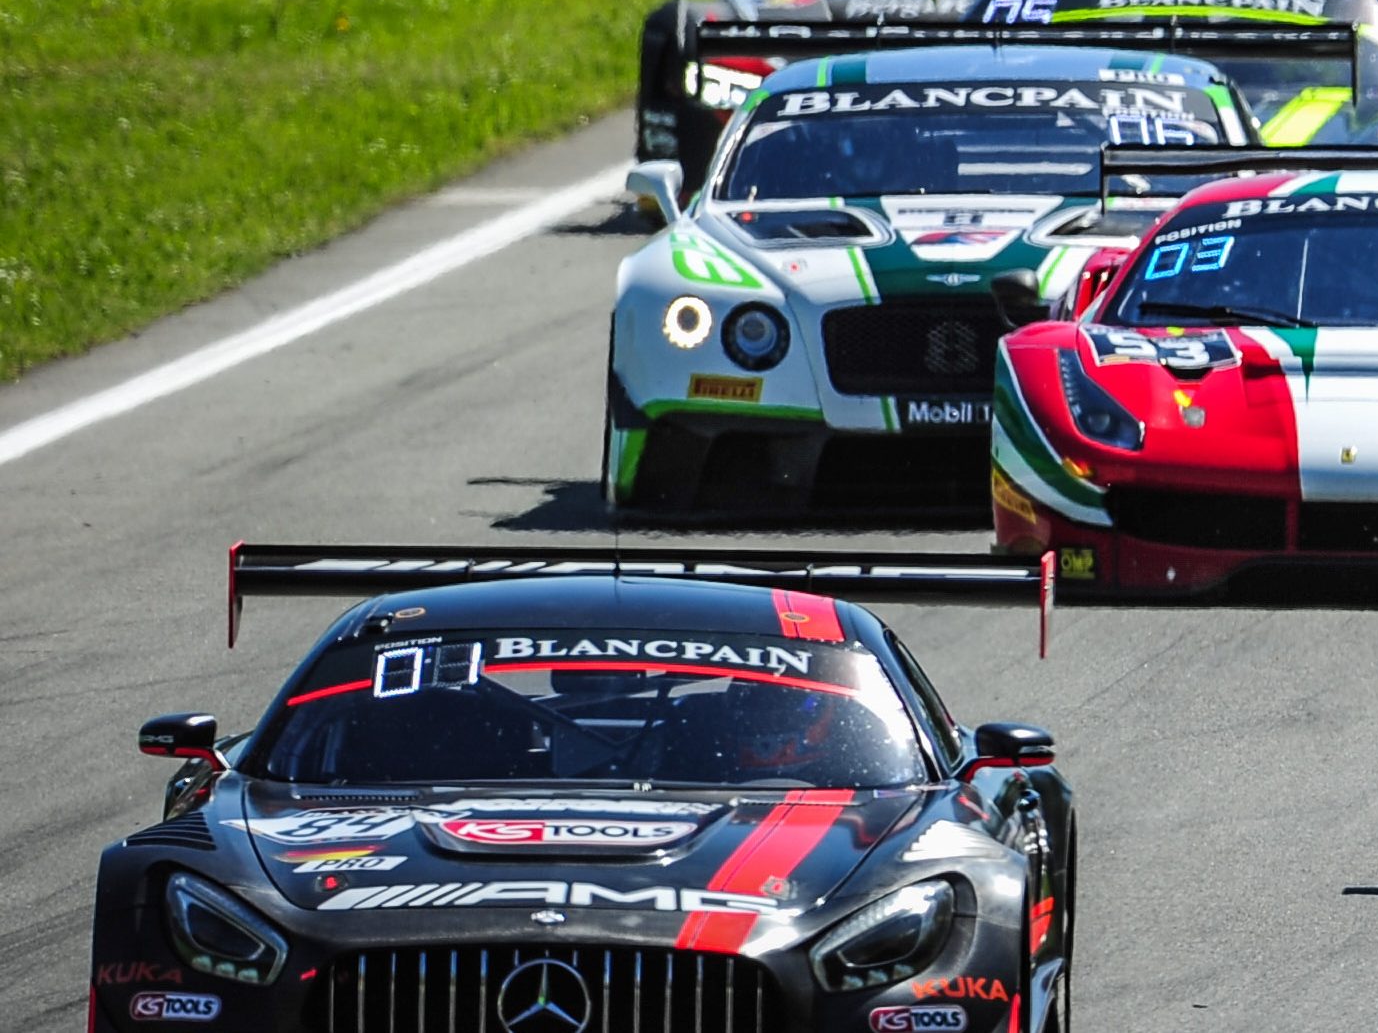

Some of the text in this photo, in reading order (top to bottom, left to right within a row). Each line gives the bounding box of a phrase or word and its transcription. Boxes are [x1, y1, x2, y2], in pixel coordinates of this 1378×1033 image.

[777, 86, 1188, 117] BLANCPAIN
[1154, 218, 1243, 246] POSITION
[1144, 235, 1236, 281] 03
[1106, 331, 1211, 368] 53
[908, 400, 974, 424] Mobil
[374, 635, 443, 652] POSITION
[494, 636, 813, 675] BLANCPAIN
[373, 640, 482, 698] 01
[457, 821, 674, 840] KS TOOLS
[312, 857, 386, 871] PRO
[453, 881, 781, 914] AMG
[97, 961, 185, 986] KUKA
[911, 974, 1009, 1003] KUKA
[134, 995, 215, 1016] KS TOOLS
[877, 1011, 962, 1031] KS TOOLS
